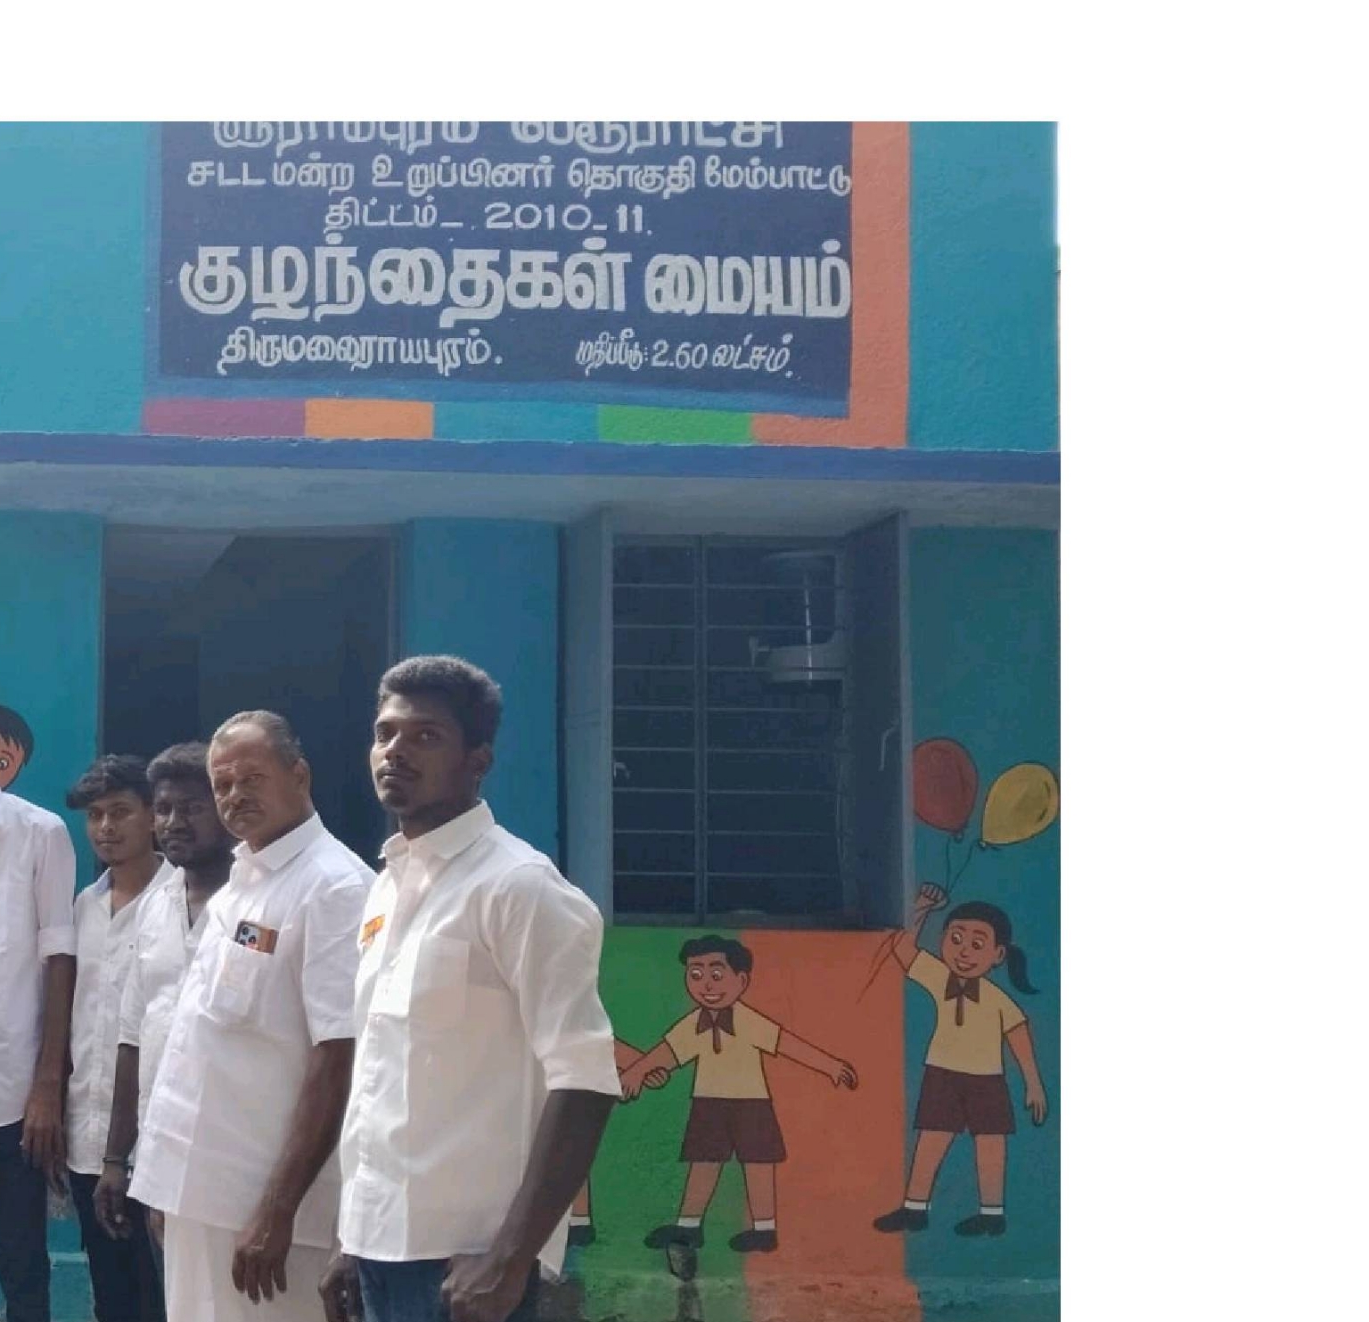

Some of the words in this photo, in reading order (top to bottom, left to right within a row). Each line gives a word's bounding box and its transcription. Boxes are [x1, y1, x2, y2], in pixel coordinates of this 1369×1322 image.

[567, 157, 696, 199] தொகுதி
[179, 234, 632, 328] குழந்தைகள்
[645, 239, 851, 319] மையம்
